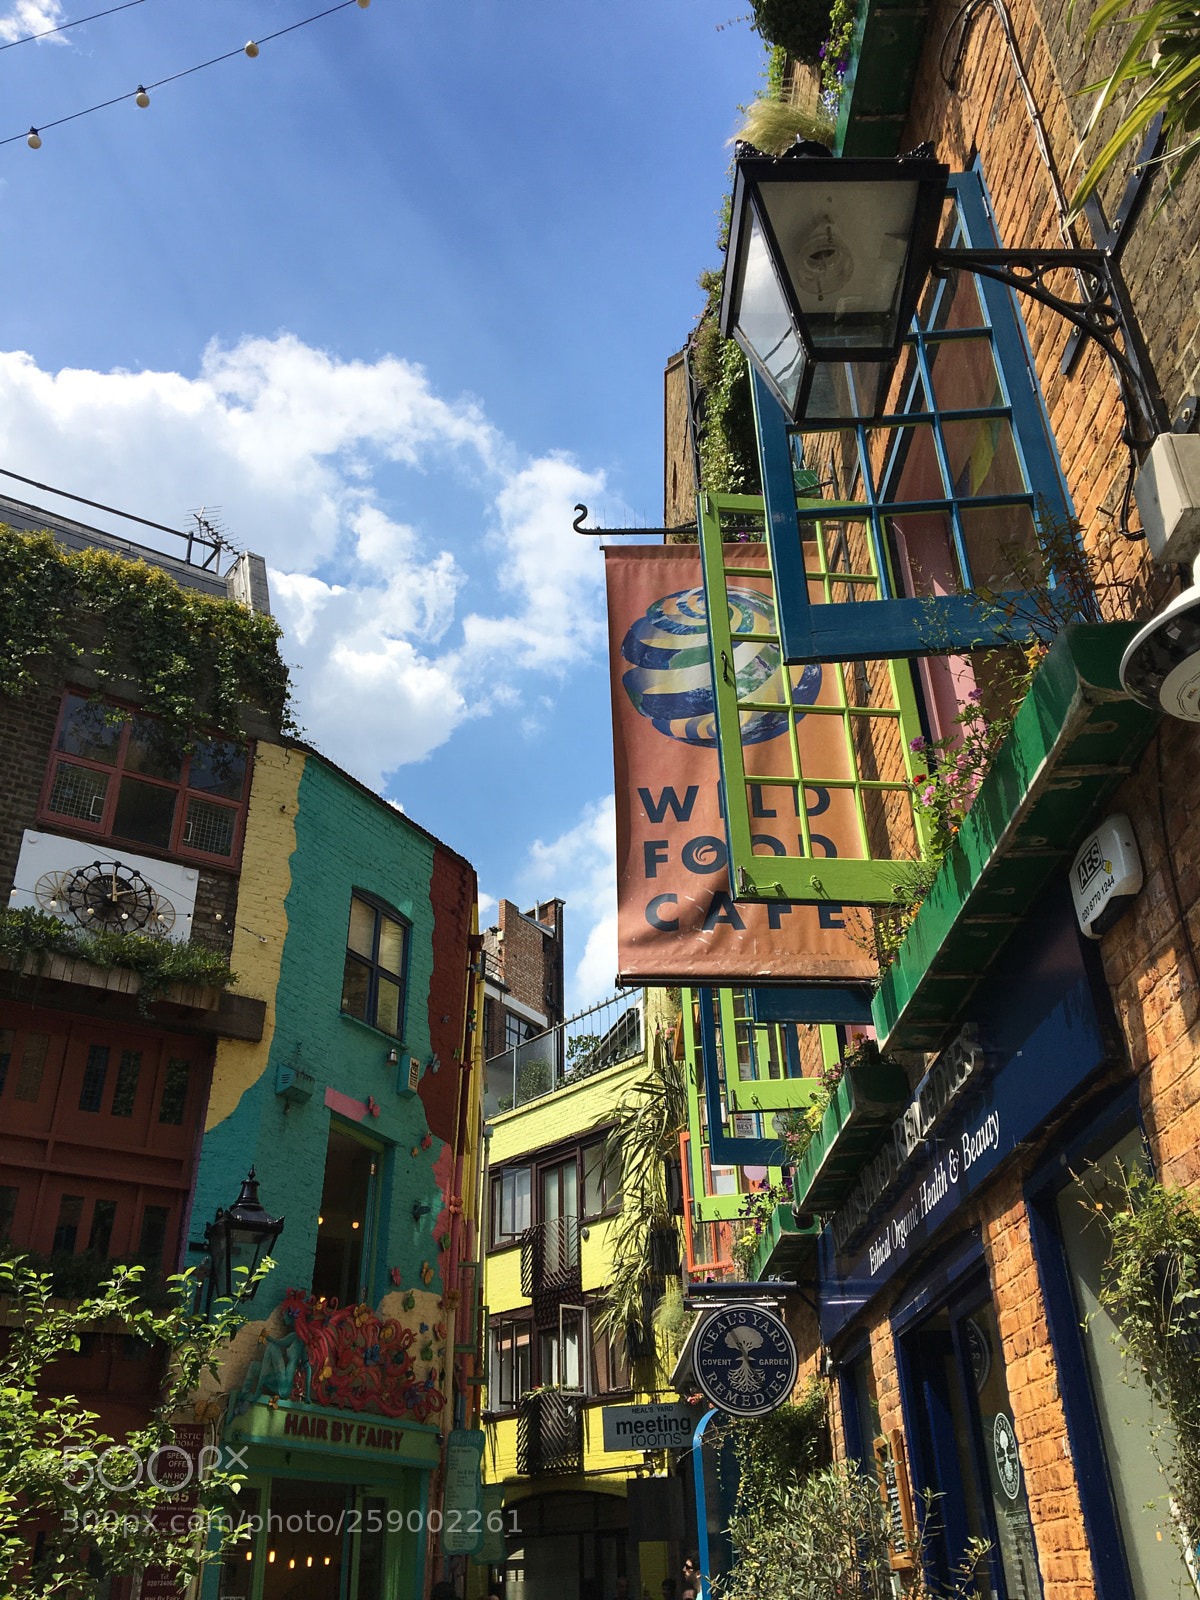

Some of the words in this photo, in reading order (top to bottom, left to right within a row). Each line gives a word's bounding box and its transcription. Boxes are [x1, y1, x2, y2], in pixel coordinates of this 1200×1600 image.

[637, 779, 831, 823] WILD
[1080, 843, 1101, 887] AES
[1082, 908, 1090, 922] 020
[1089, 890, 1102, 911] 8770
[1101, 874, 1115, 896] 1244
[891, 1022, 984, 1172] REMEDIES
[868, 1225, 892, 1277] Ethical
[891, 1196, 920, 1249] Organic
[919, 1161, 949, 1220] Health
[948, 1148, 960, 1184] &
[961, 1110, 1000, 1172] Beauty
[702, 1312, 747, 1355] NEAL'S
[752, 1313, 787, 1353] YARD
[702, 1358, 731, 1366] COVENT
[758, 1358, 789, 1366] GARDEN
[705, 1370, 787, 1407] REMEDIES
[616, 1414, 692, 1435] meeting
[631, 1406, 654, 1414] NEAL'S
[284, 1413, 328, 1440] HAIR
[330, 1421, 355, 1444] BY
[356, 1425, 404, 1451] FAIRY
[631, 1432, 682, 1447] rooms
